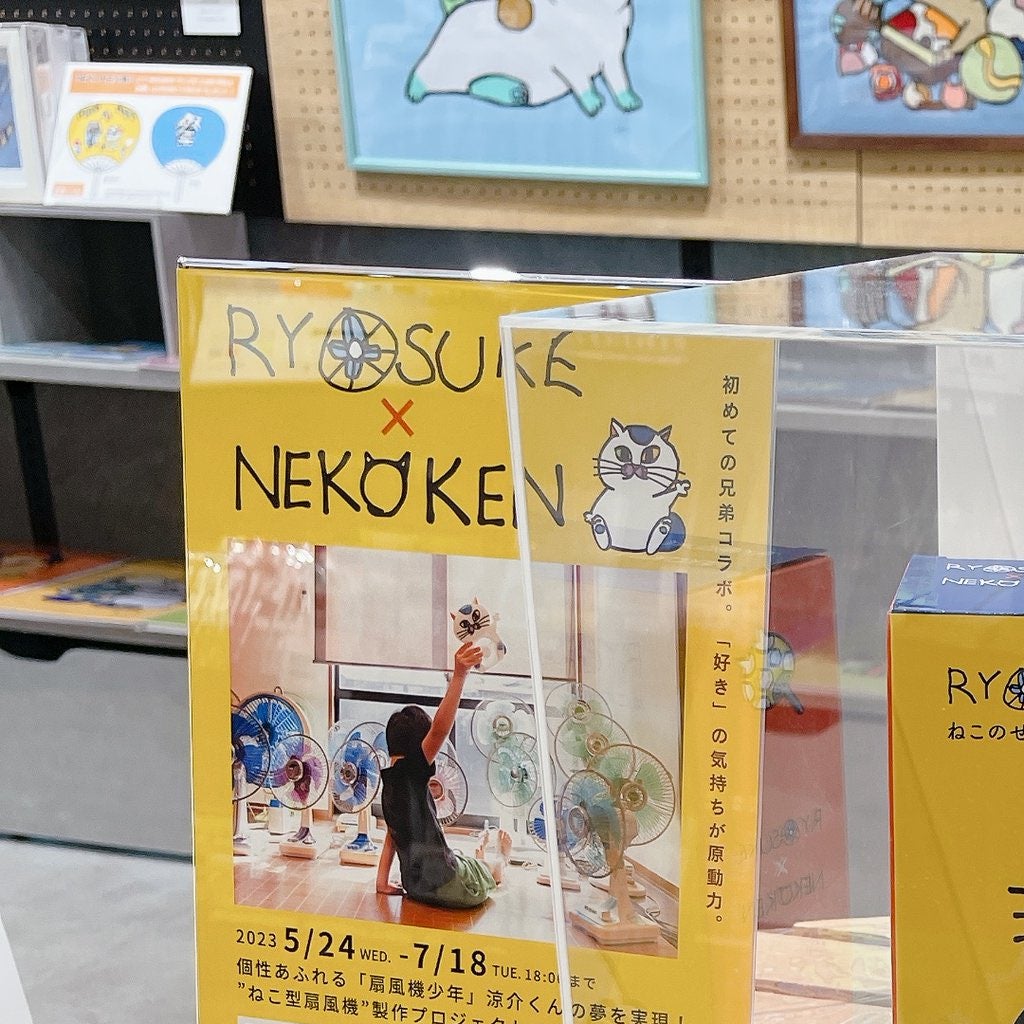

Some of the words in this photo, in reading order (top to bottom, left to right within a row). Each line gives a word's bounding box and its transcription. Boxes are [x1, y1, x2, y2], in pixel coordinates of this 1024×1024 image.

[227, 304, 583, 397] RYOSUKE
[234, 445, 566, 530] NEKOKEN
[715, 375, 740, 612] 初めての兄弟コラボ。
[705, 640, 731, 924] 「好き」の気持ちが原動力。
[236, 929, 278, 947] 2023
[283, 927, 356, 960] 5/24
